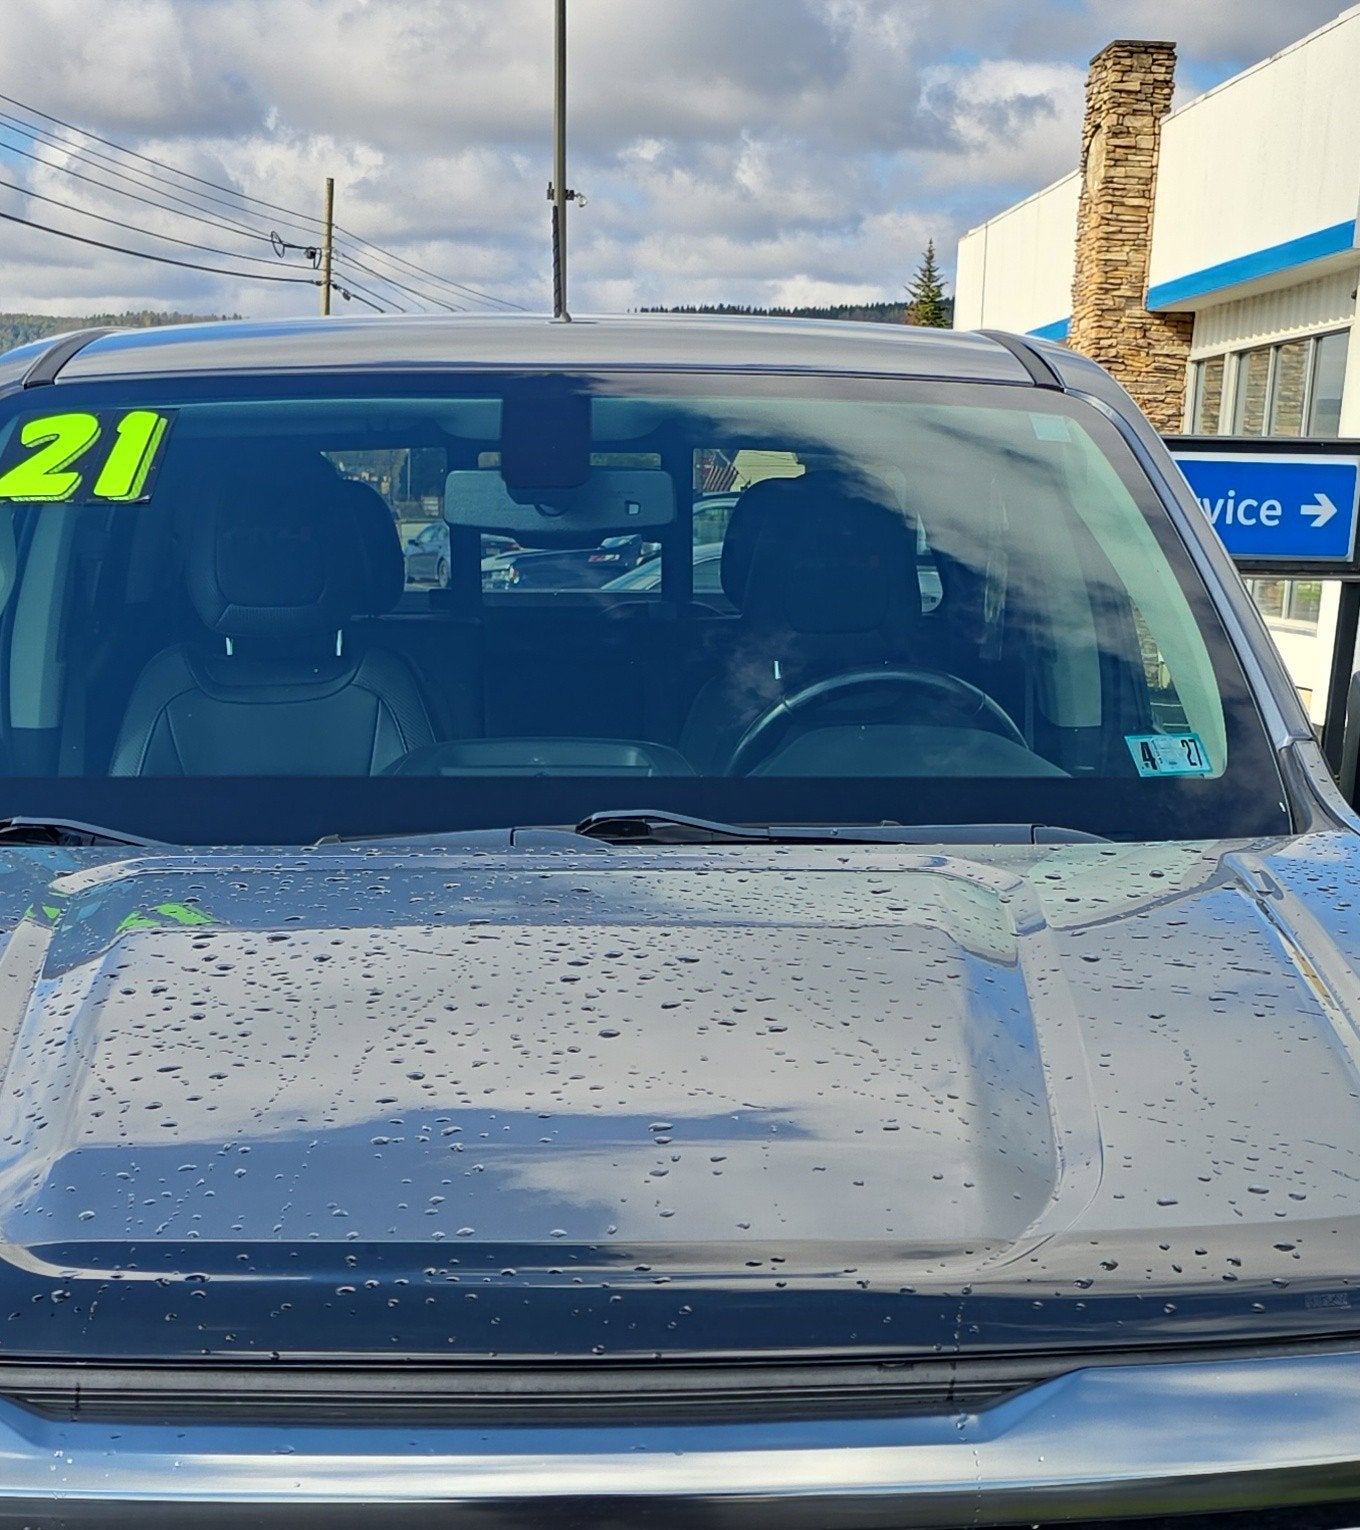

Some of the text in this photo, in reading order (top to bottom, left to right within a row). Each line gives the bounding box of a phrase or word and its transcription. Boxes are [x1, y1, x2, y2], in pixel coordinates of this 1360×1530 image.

[1196, 489, 1283, 526] vice
[1140, 738, 1203, 771] 4 27
